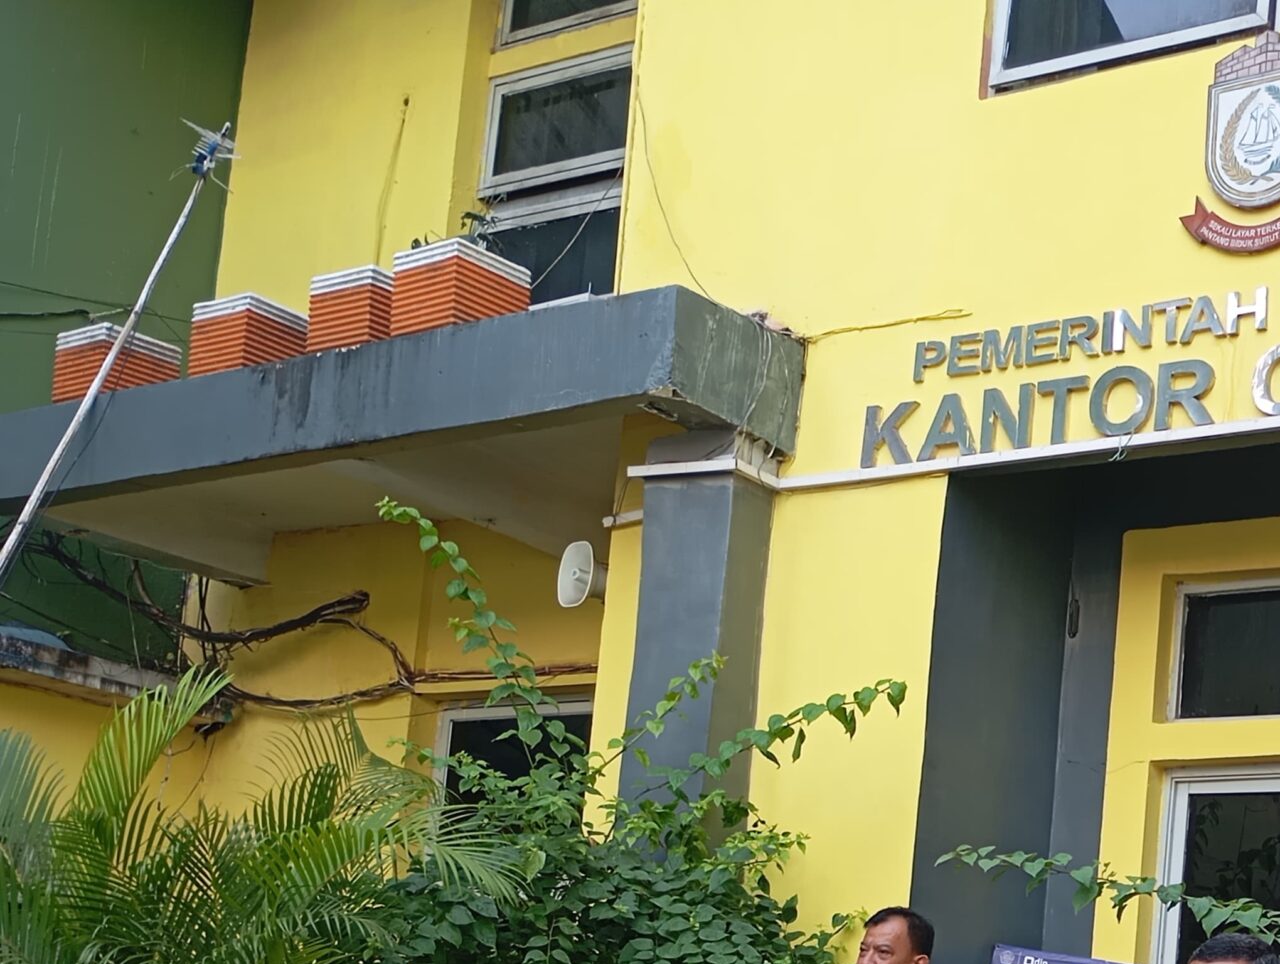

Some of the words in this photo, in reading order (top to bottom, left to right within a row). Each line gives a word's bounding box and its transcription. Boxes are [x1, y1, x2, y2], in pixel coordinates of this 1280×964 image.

[1200, 226, 1230, 247] PANTANG
[1208, 220, 1232, 236] SEKALI
[1232, 229, 1256, 237] LAYAR
[913, 286, 1268, 383] PEMERINTAH
[860, 359, 1217, 468] KANTOR
